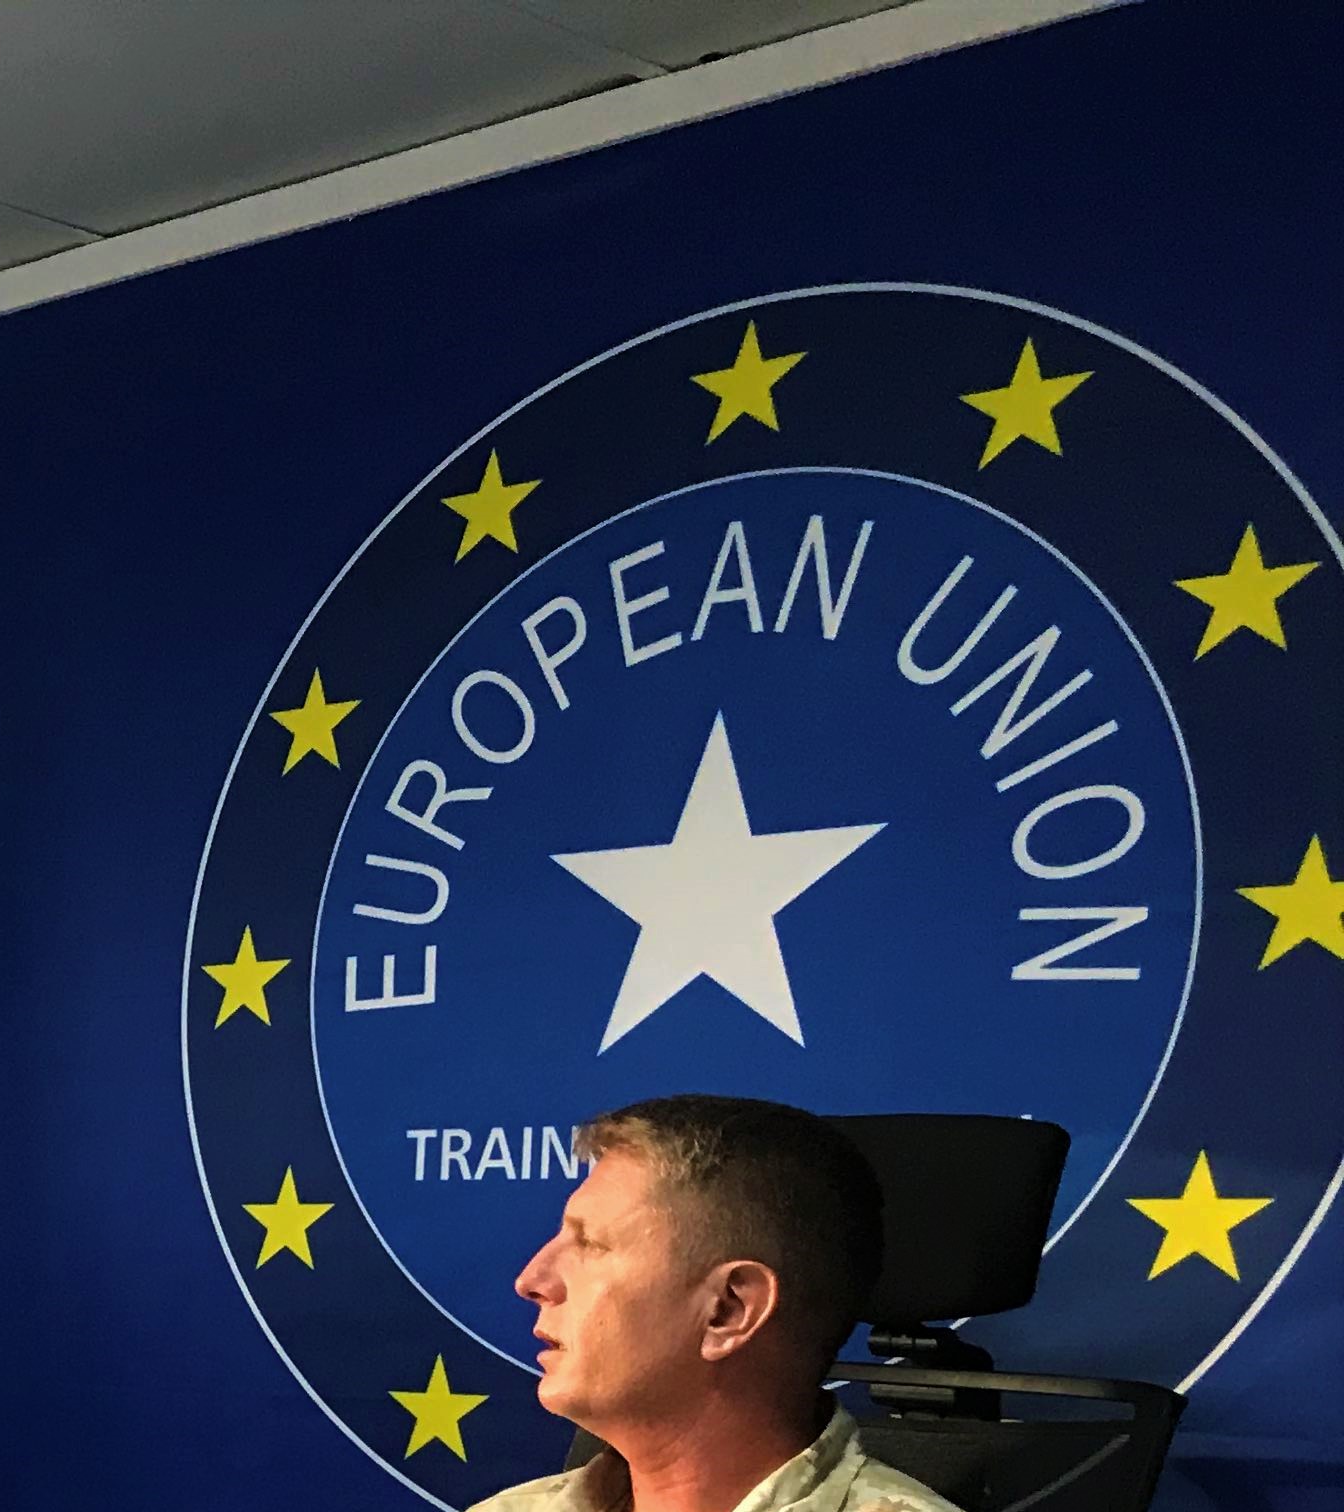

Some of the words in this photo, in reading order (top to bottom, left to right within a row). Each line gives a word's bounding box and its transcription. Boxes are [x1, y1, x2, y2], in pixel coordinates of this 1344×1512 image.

[345, 515, 874, 1012] EUROPEAN
[897, 556, 1149, 983] UNION
[406, 1125, 598, 1182] TRAIN
